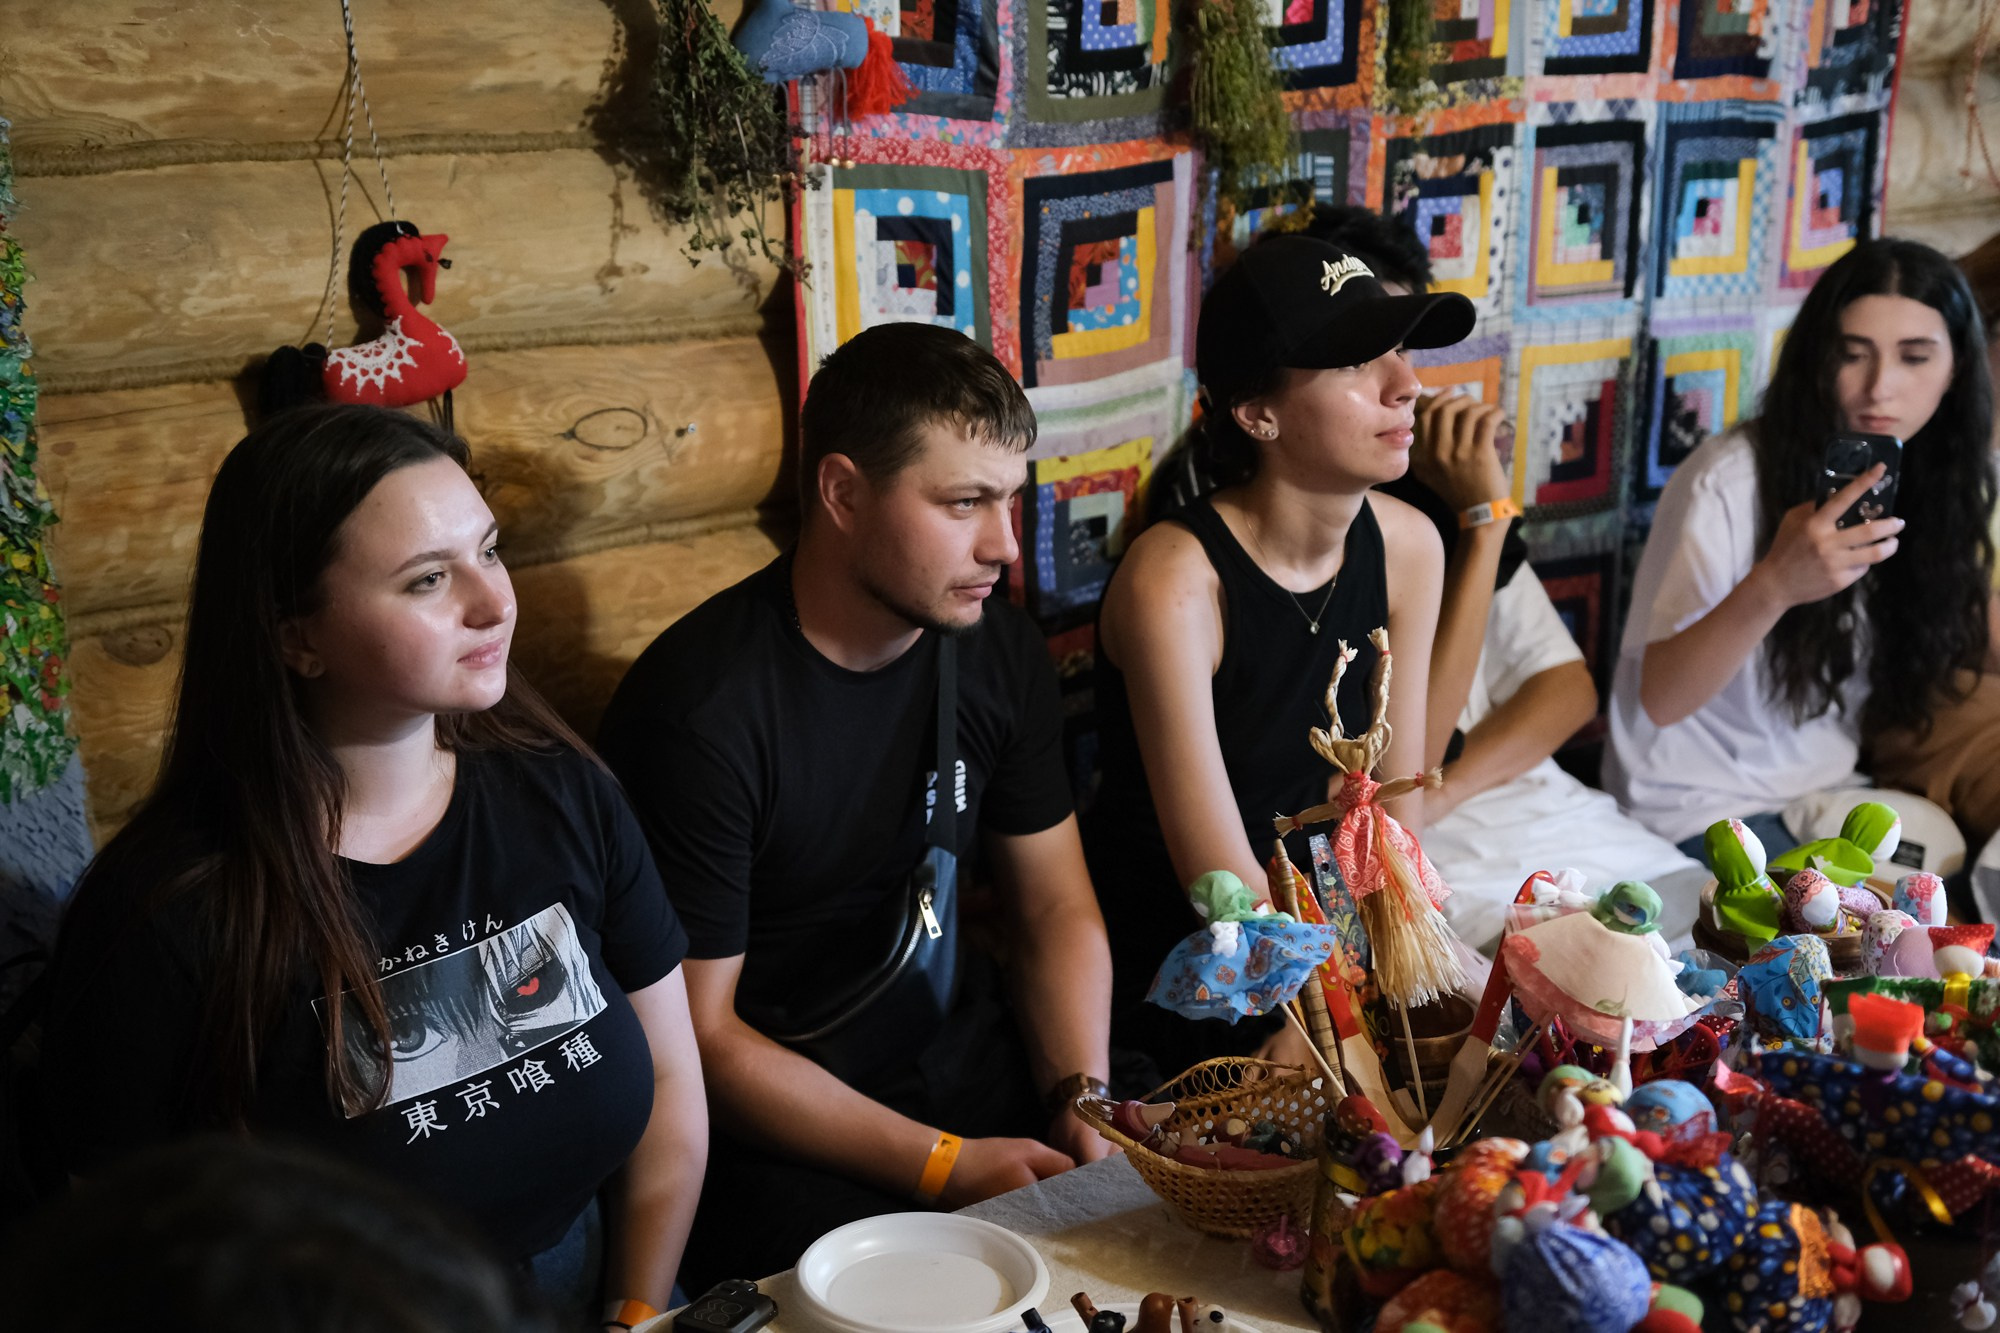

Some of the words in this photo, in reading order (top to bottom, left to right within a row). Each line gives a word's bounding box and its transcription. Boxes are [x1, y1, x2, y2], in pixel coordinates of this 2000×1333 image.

[378, 913, 503, 973] かねきけん
[401, 1031, 602, 1144] 東京喰種
